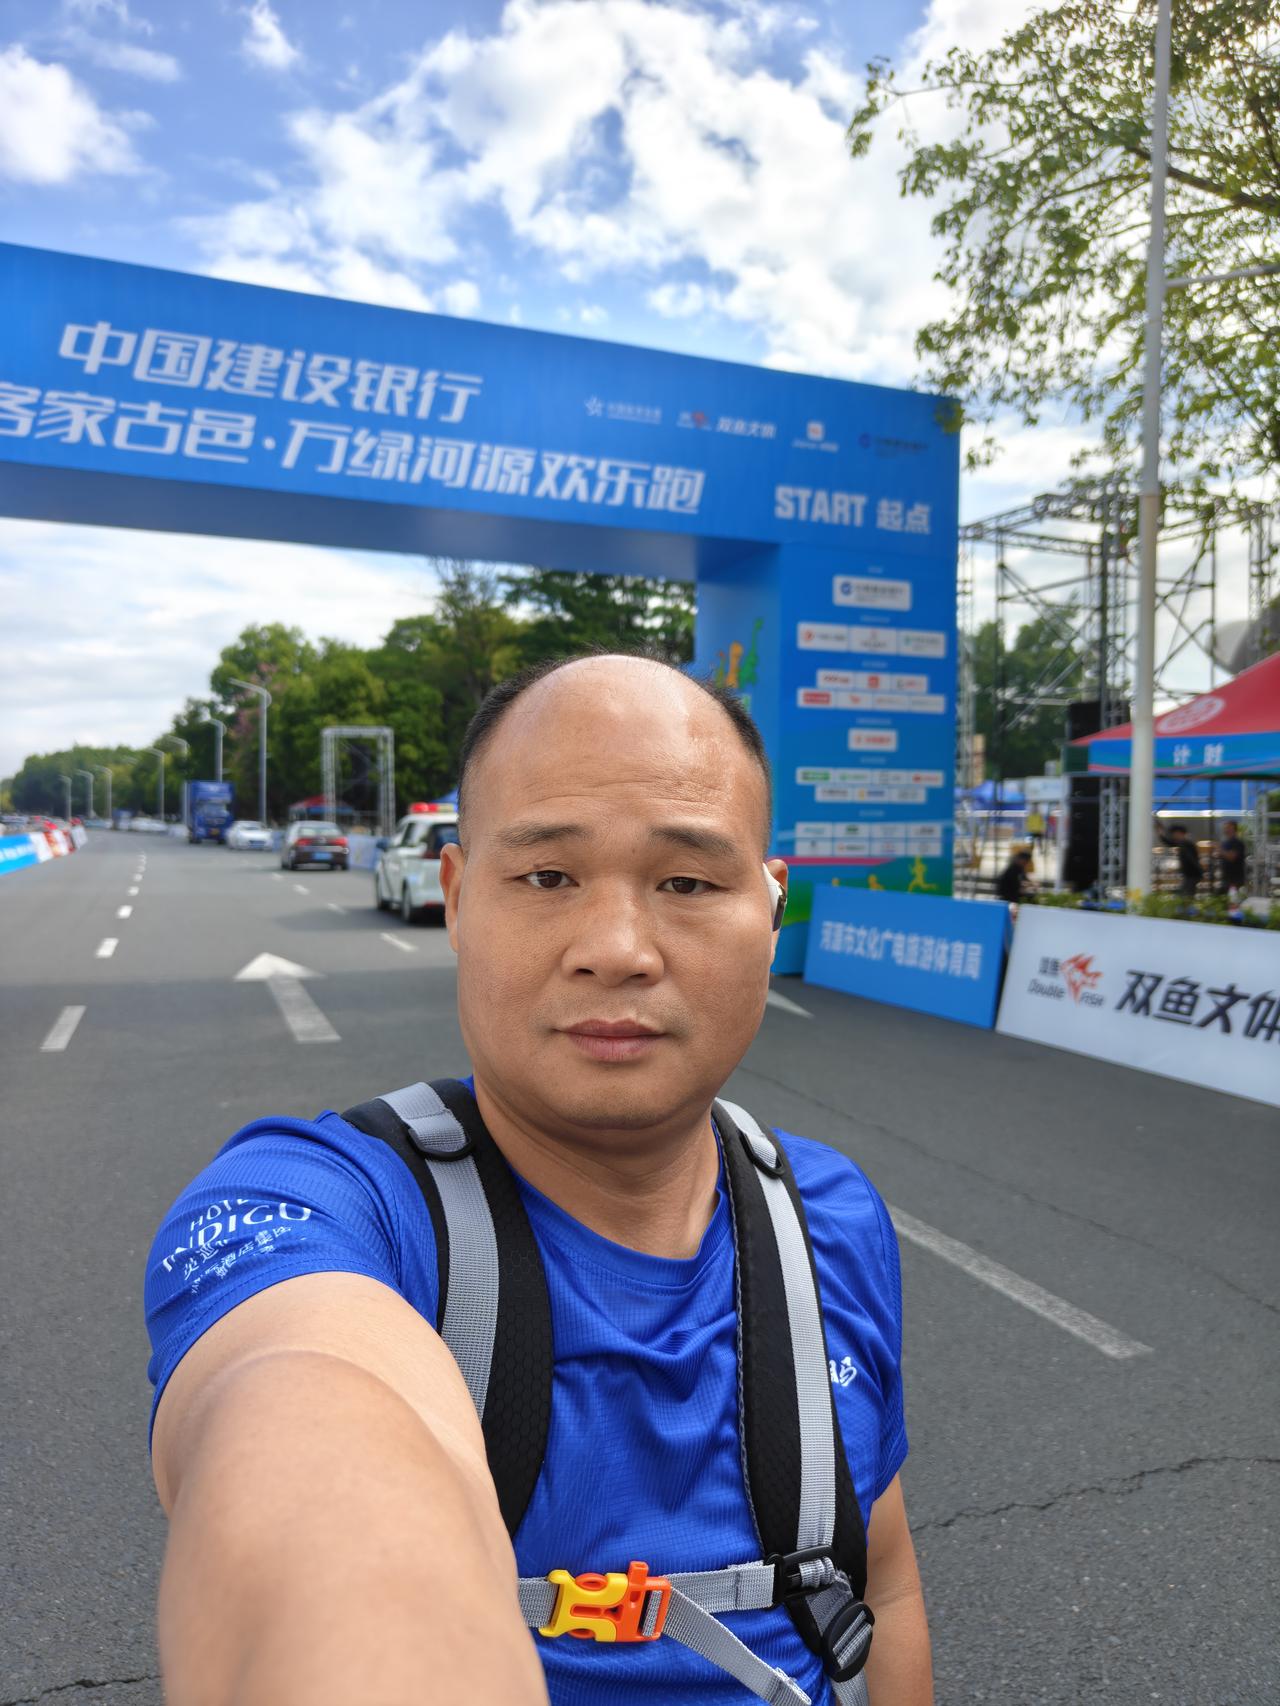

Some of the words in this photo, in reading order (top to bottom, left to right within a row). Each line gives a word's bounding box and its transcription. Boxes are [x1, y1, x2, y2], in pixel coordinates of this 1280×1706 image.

[59, 321, 484, 424] 中国建设银行
[774, 484, 868, 528] START
[876, 498, 931, 535] 起点
